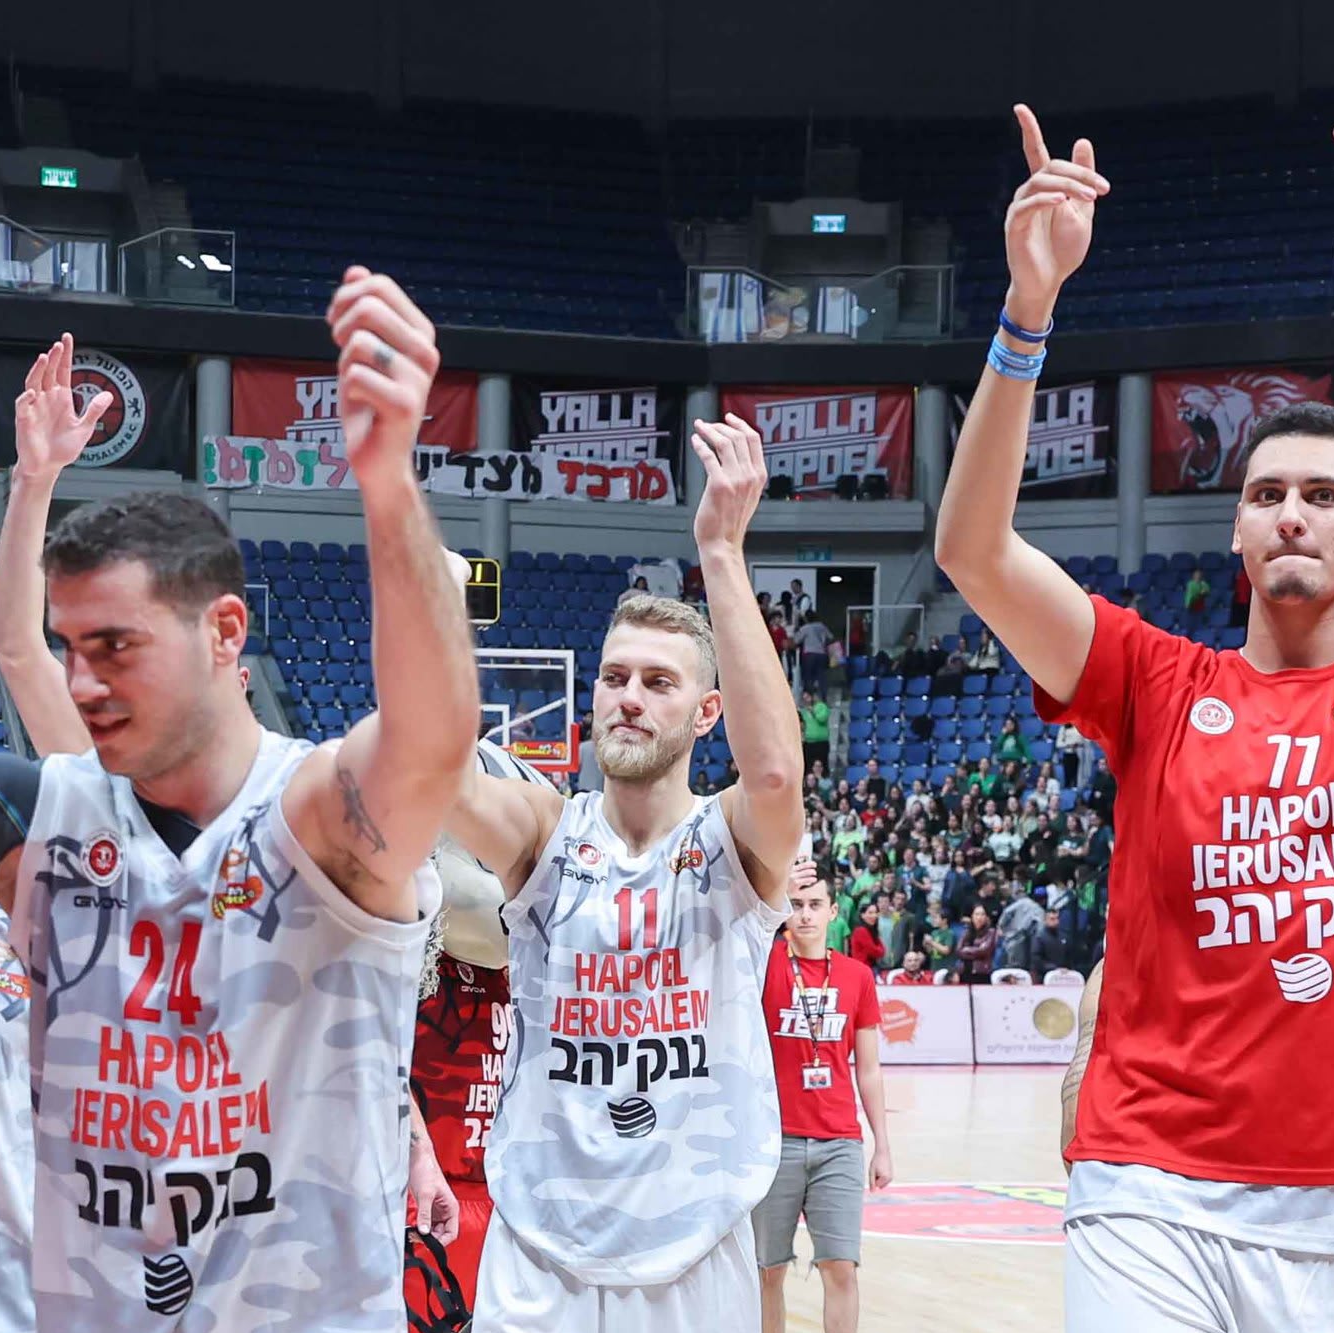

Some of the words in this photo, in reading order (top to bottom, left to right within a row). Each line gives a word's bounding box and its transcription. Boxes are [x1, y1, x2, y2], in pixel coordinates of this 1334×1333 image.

[540, 392, 657, 433] YALLA
[756, 395, 878, 444] YALLA
[79, 440, 128, 461] RUSALEM
[767, 442, 889, 480] APOEL
[1267, 733, 1321, 789] 77
[613, 888, 659, 952] 11
[1193, 889, 1294, 950] יהב
[122, 920, 205, 1025] 24
[575, 947, 689, 993] HAPOEL
[549, 990, 709, 1037] JERUSALEM
[548, 1037, 630, 1087] יהב
